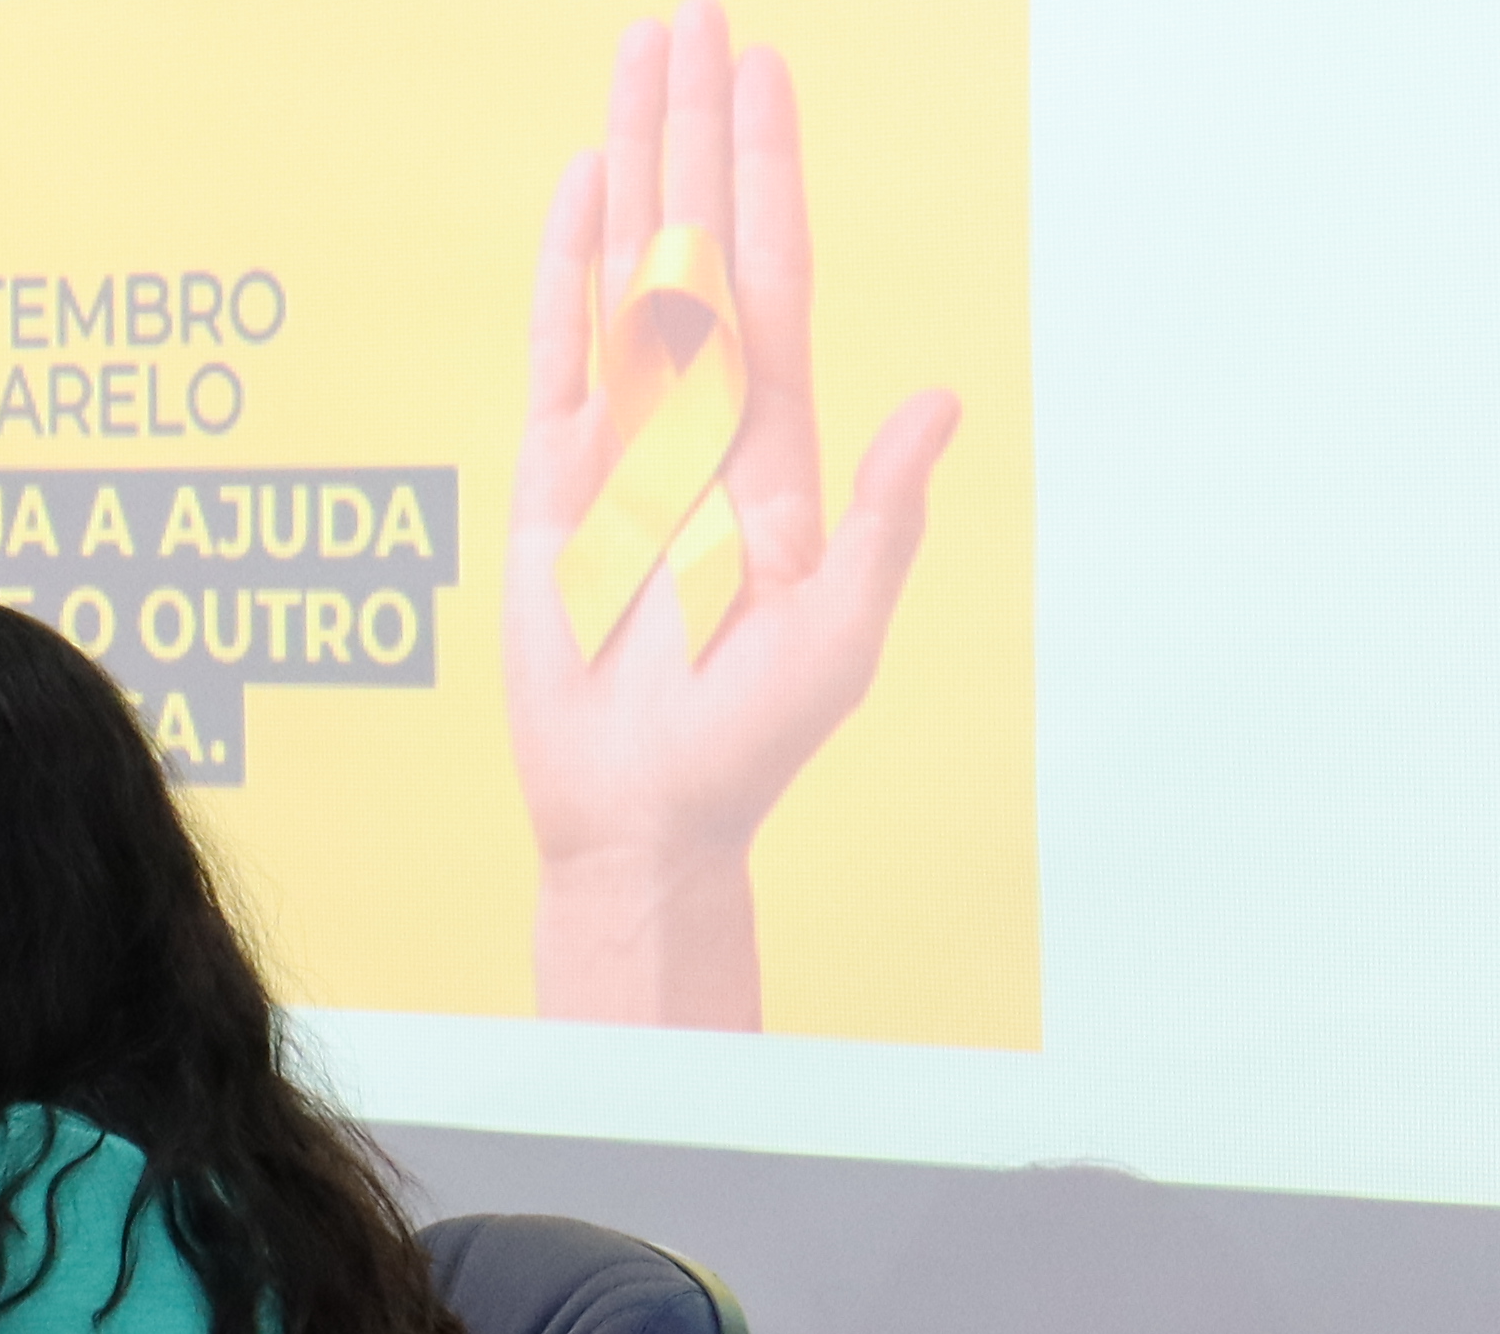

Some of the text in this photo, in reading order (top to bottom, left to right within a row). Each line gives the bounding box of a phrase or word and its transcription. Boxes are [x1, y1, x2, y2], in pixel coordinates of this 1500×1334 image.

[80, 482, 136, 559] A
[159, 480, 434, 561] AJUDA
[138, 584, 419, 666] OUTRO
